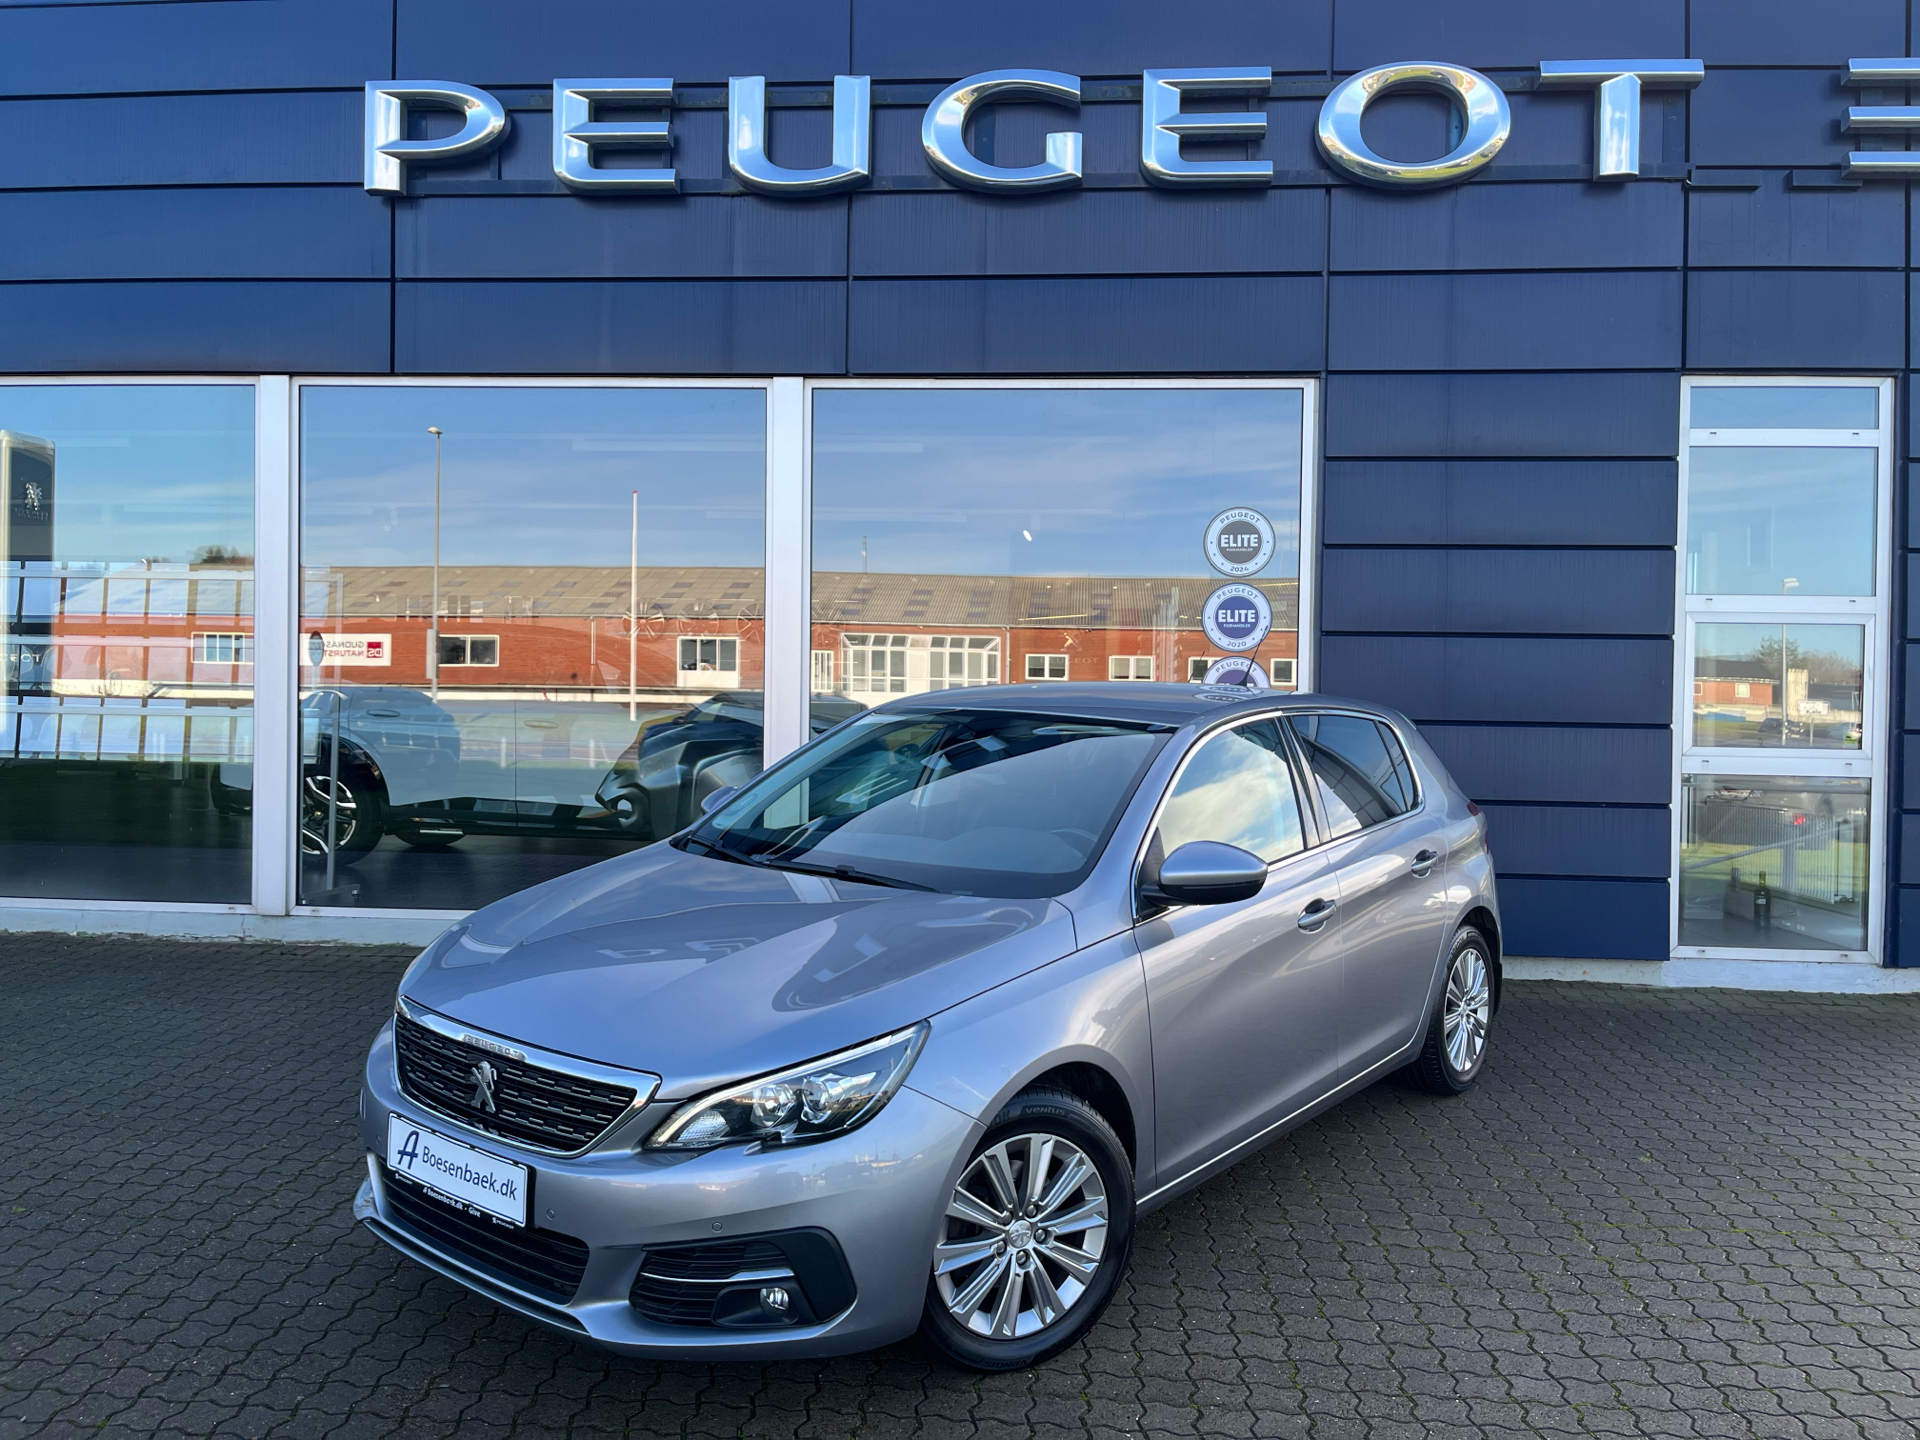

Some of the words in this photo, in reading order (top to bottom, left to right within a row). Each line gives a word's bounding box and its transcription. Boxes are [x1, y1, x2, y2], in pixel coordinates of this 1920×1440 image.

[364, 61, 1705, 196] PEUGEOT
[1219, 511, 1261, 524] PEUGEOT
[1220, 534, 1259, 548] ELITE
[1216, 587, 1259, 600] PEUGEOT
[1217, 609, 1256, 623] ELITE
[422, 1146, 518, 1201] Boesenbaek.dk
